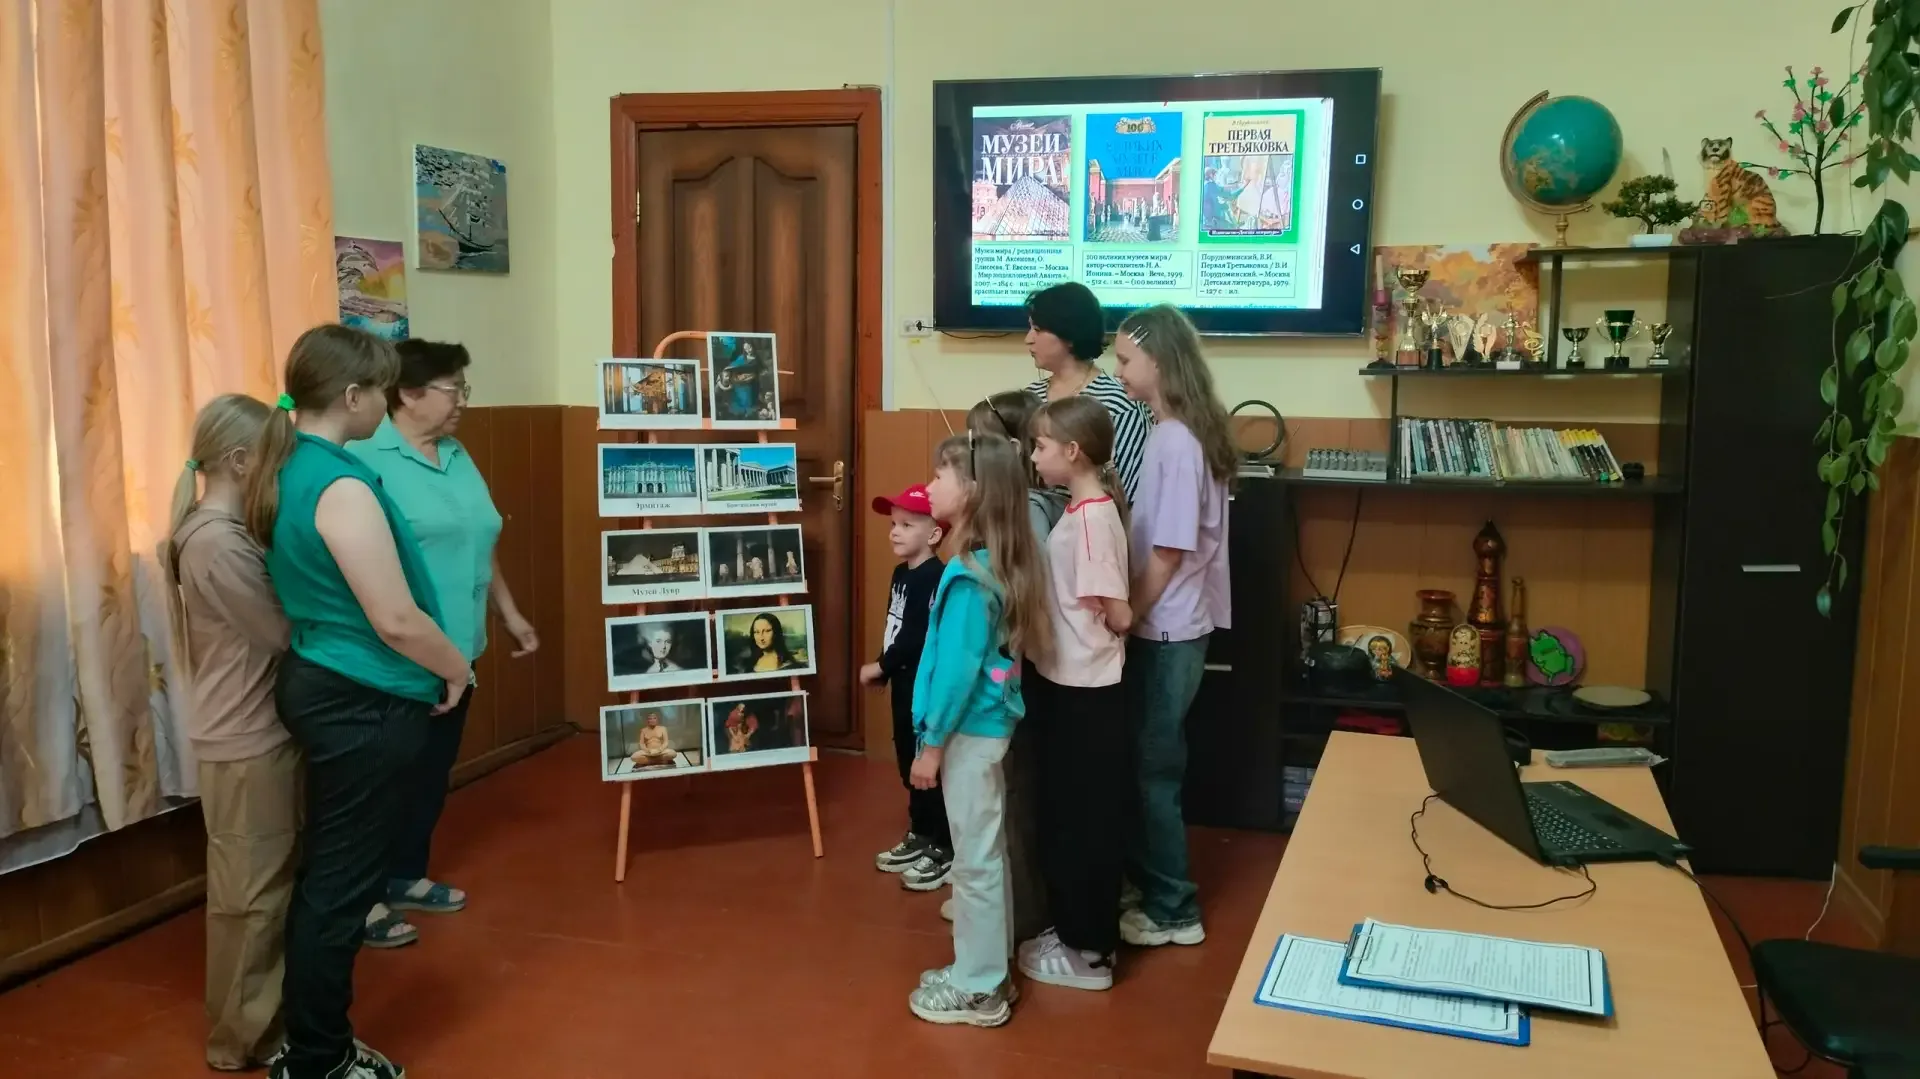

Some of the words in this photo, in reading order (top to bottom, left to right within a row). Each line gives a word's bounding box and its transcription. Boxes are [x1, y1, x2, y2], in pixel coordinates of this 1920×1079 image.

[1127, 123, 1144, 132] 100
[1228, 129, 1271, 140] ПЕРВАЯ
[981, 133, 1061, 154] МУЗЕИ
[1209, 141, 1289, 153] ТРЕТЬЯКОВКА
[981, 155, 1058, 186] МИРА
[1226, 262, 1268, 270] Третьяковка
[1203, 279, 1232, 287] Детская
[1232, 279, 1273, 287] литература,
[635, 502, 671, 510] Эрмитаж
[631, 587, 658, 596] Музей
[659, 586, 681, 596] Лувр
